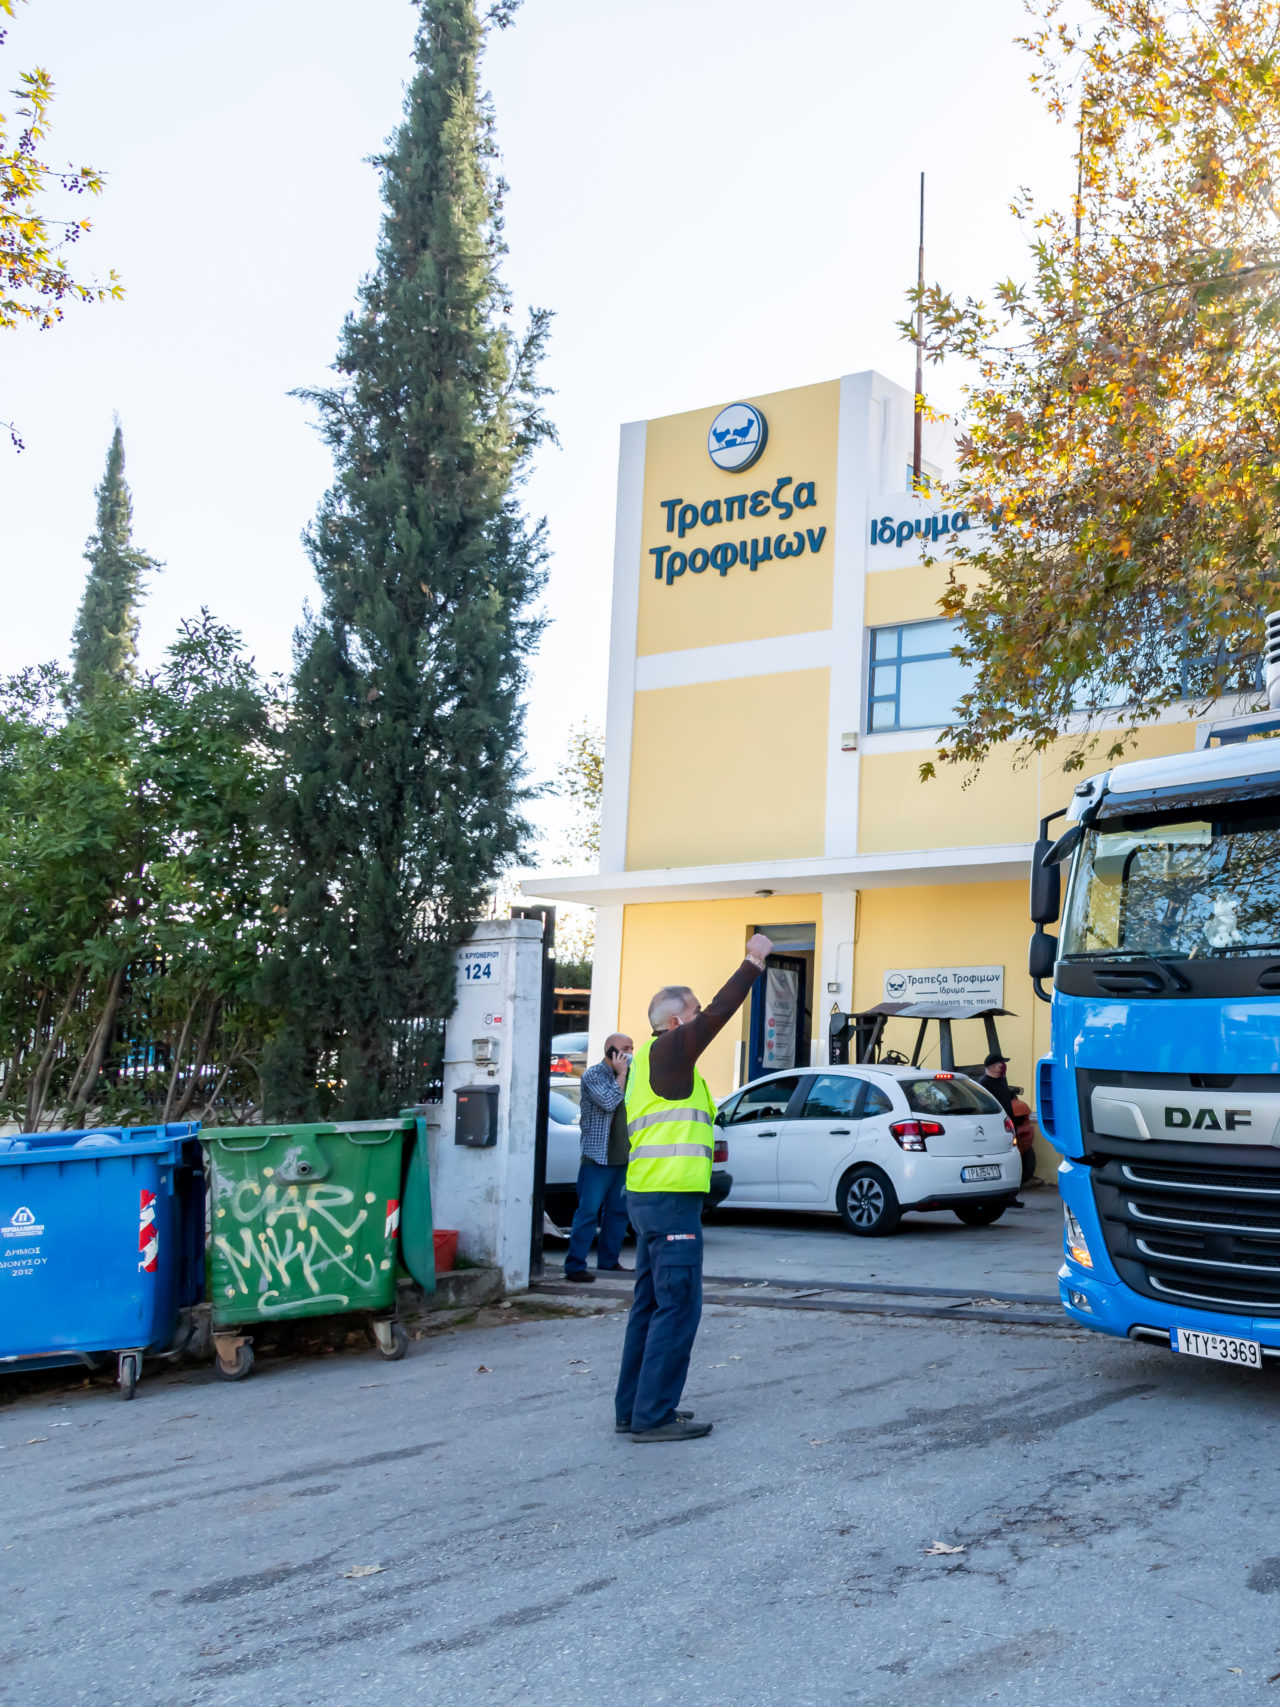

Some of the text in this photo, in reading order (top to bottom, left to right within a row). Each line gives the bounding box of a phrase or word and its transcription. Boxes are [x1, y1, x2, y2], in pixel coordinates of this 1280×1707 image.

[660, 476, 817, 537] Τραπεζα
[870, 511, 971, 547] Ιδρυμα
[648, 526, 826, 585] Τροφιμων
[465, 963, 492, 980] 124
[907, 973, 1001, 986] Τραπεζα Τροφιμων
[939, 986, 966, 995] Ιδρυμα
[1164, 1106, 1253, 1132] DAF
[5, 1246, 40, 1256] ΔΗΜΟΣ
[12, 1268, 33, 1276] 2012
